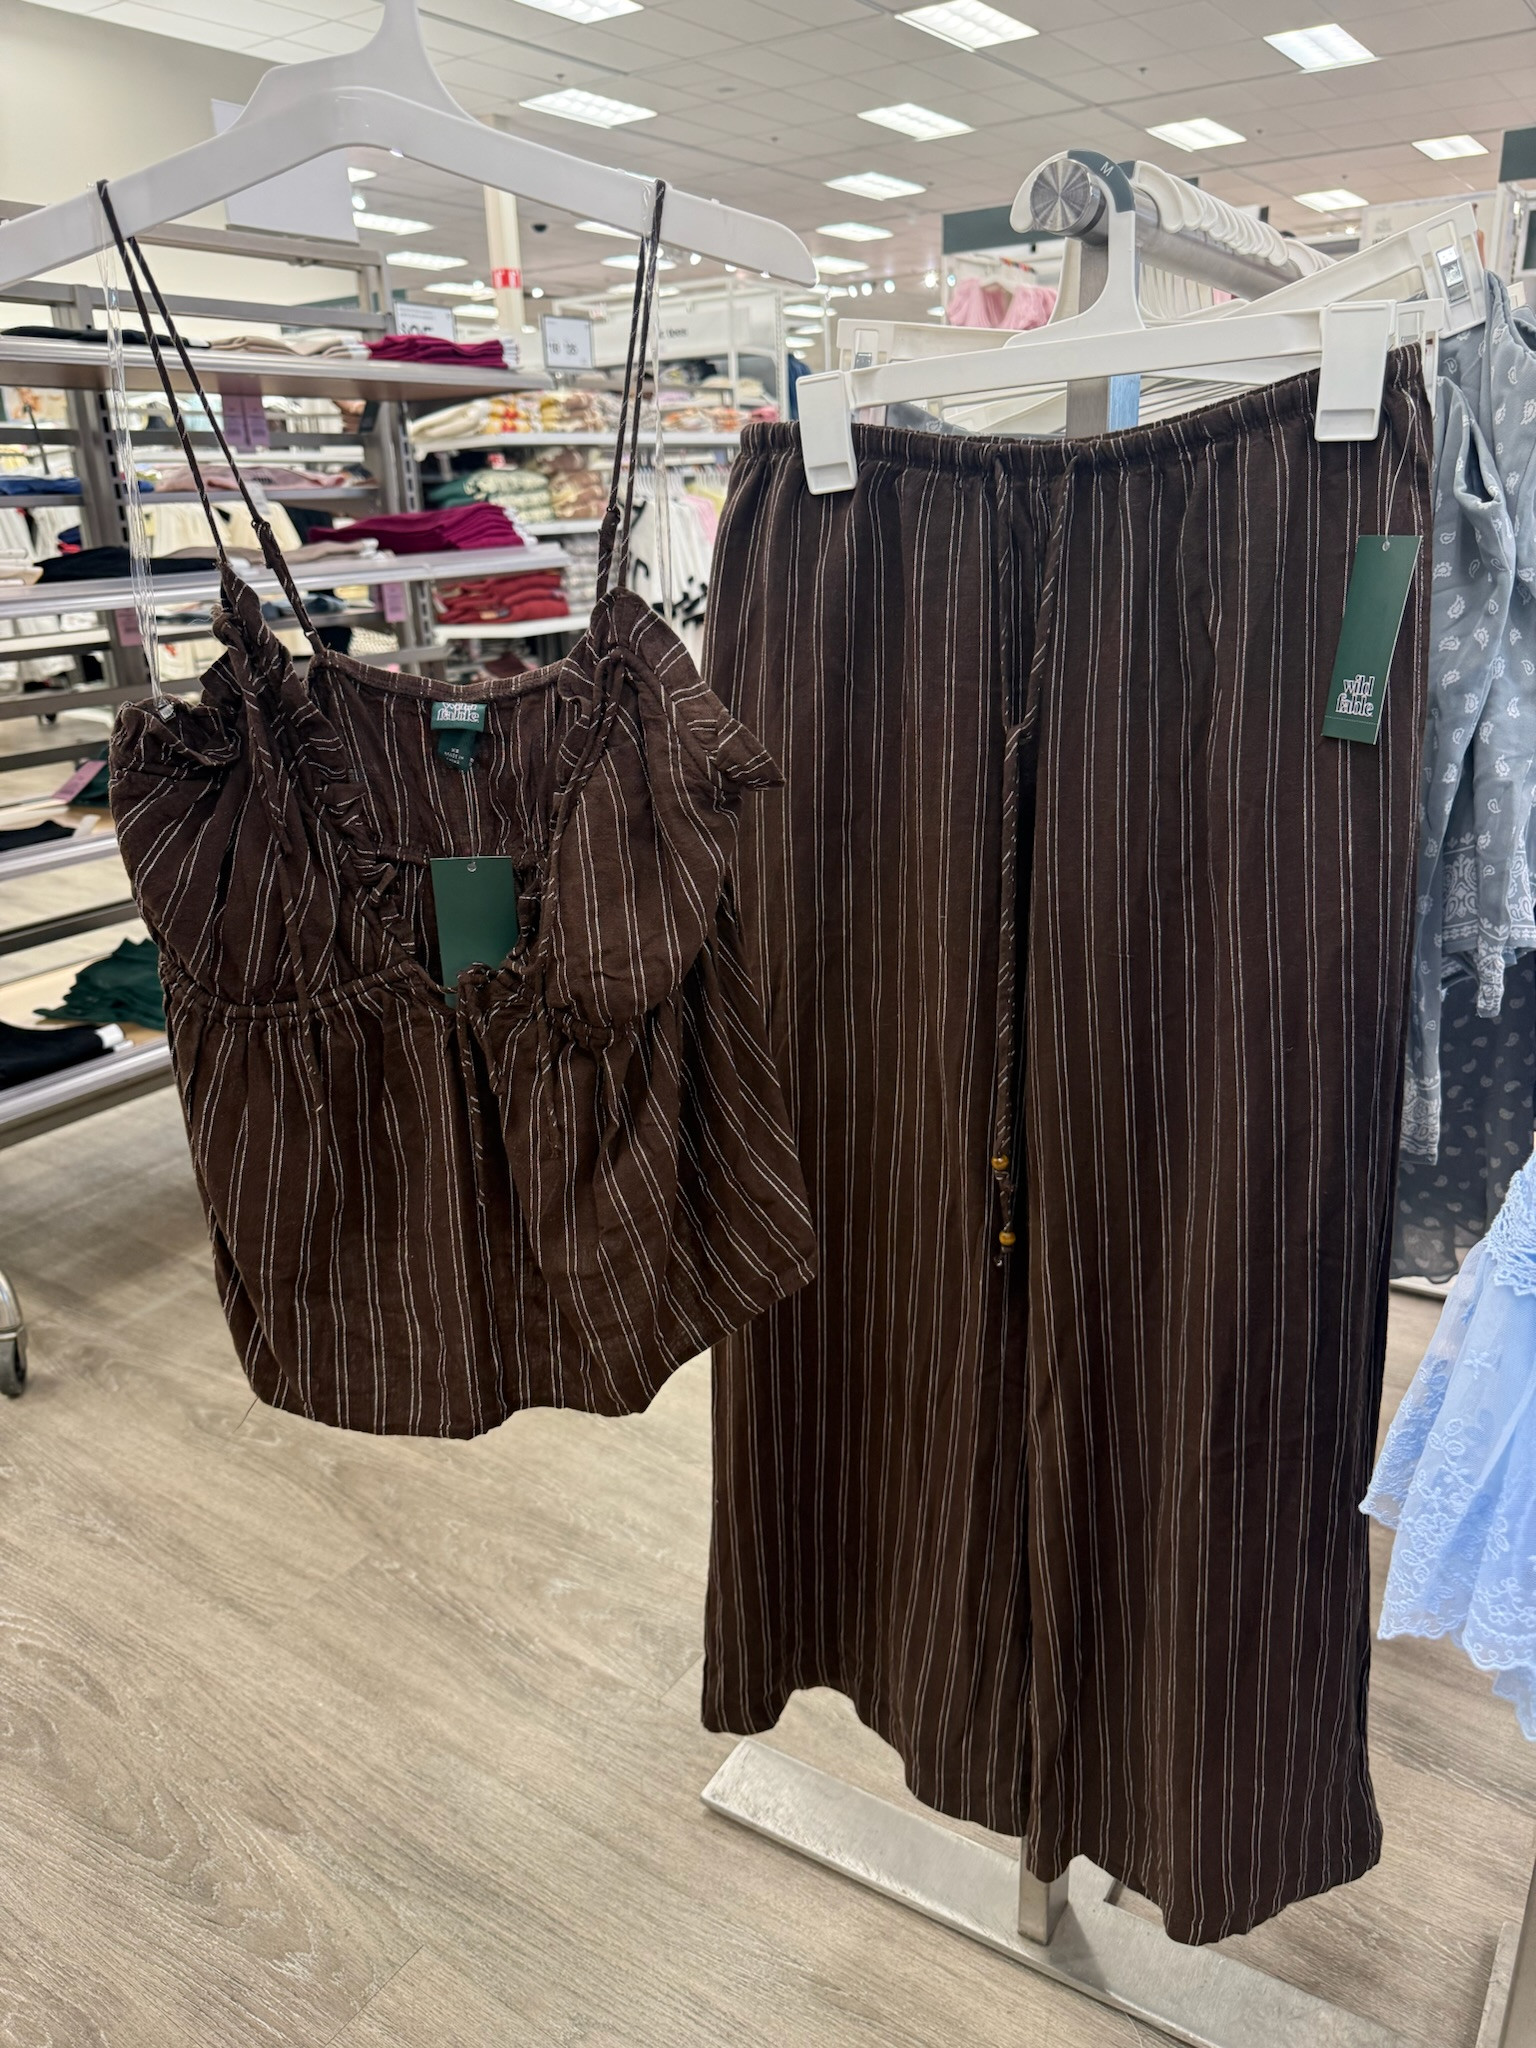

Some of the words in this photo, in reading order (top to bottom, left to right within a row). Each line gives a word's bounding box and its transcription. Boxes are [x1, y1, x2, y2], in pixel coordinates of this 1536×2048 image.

[1100, 161, 1114, 177] M
[1343, 674, 1376, 697] wild
[1335, 692, 1375, 717] fable
[436, 708, 480, 723] fable
